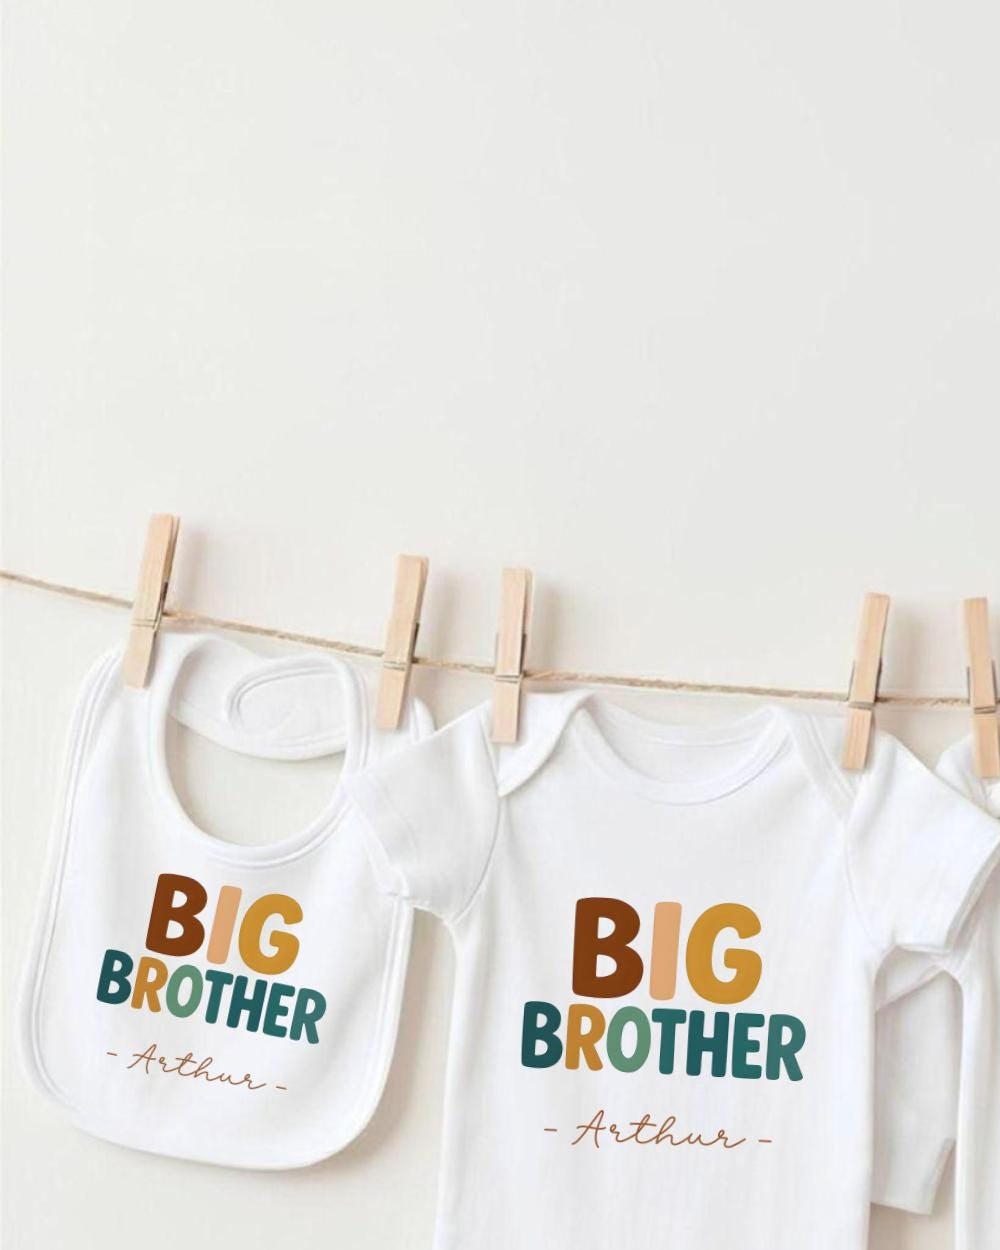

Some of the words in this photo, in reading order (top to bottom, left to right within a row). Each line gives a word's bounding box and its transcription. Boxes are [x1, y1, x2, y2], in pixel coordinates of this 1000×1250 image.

[145, 873, 303, 976] BIG
[572, 897, 762, 1005] BIG
[97, 949, 326, 1044] BROTHER
[521, 1000, 805, 1081] BROTHER
[127, 1043, 267, 1090] Arthur
[571, 1109, 746, 1149] Arthur
